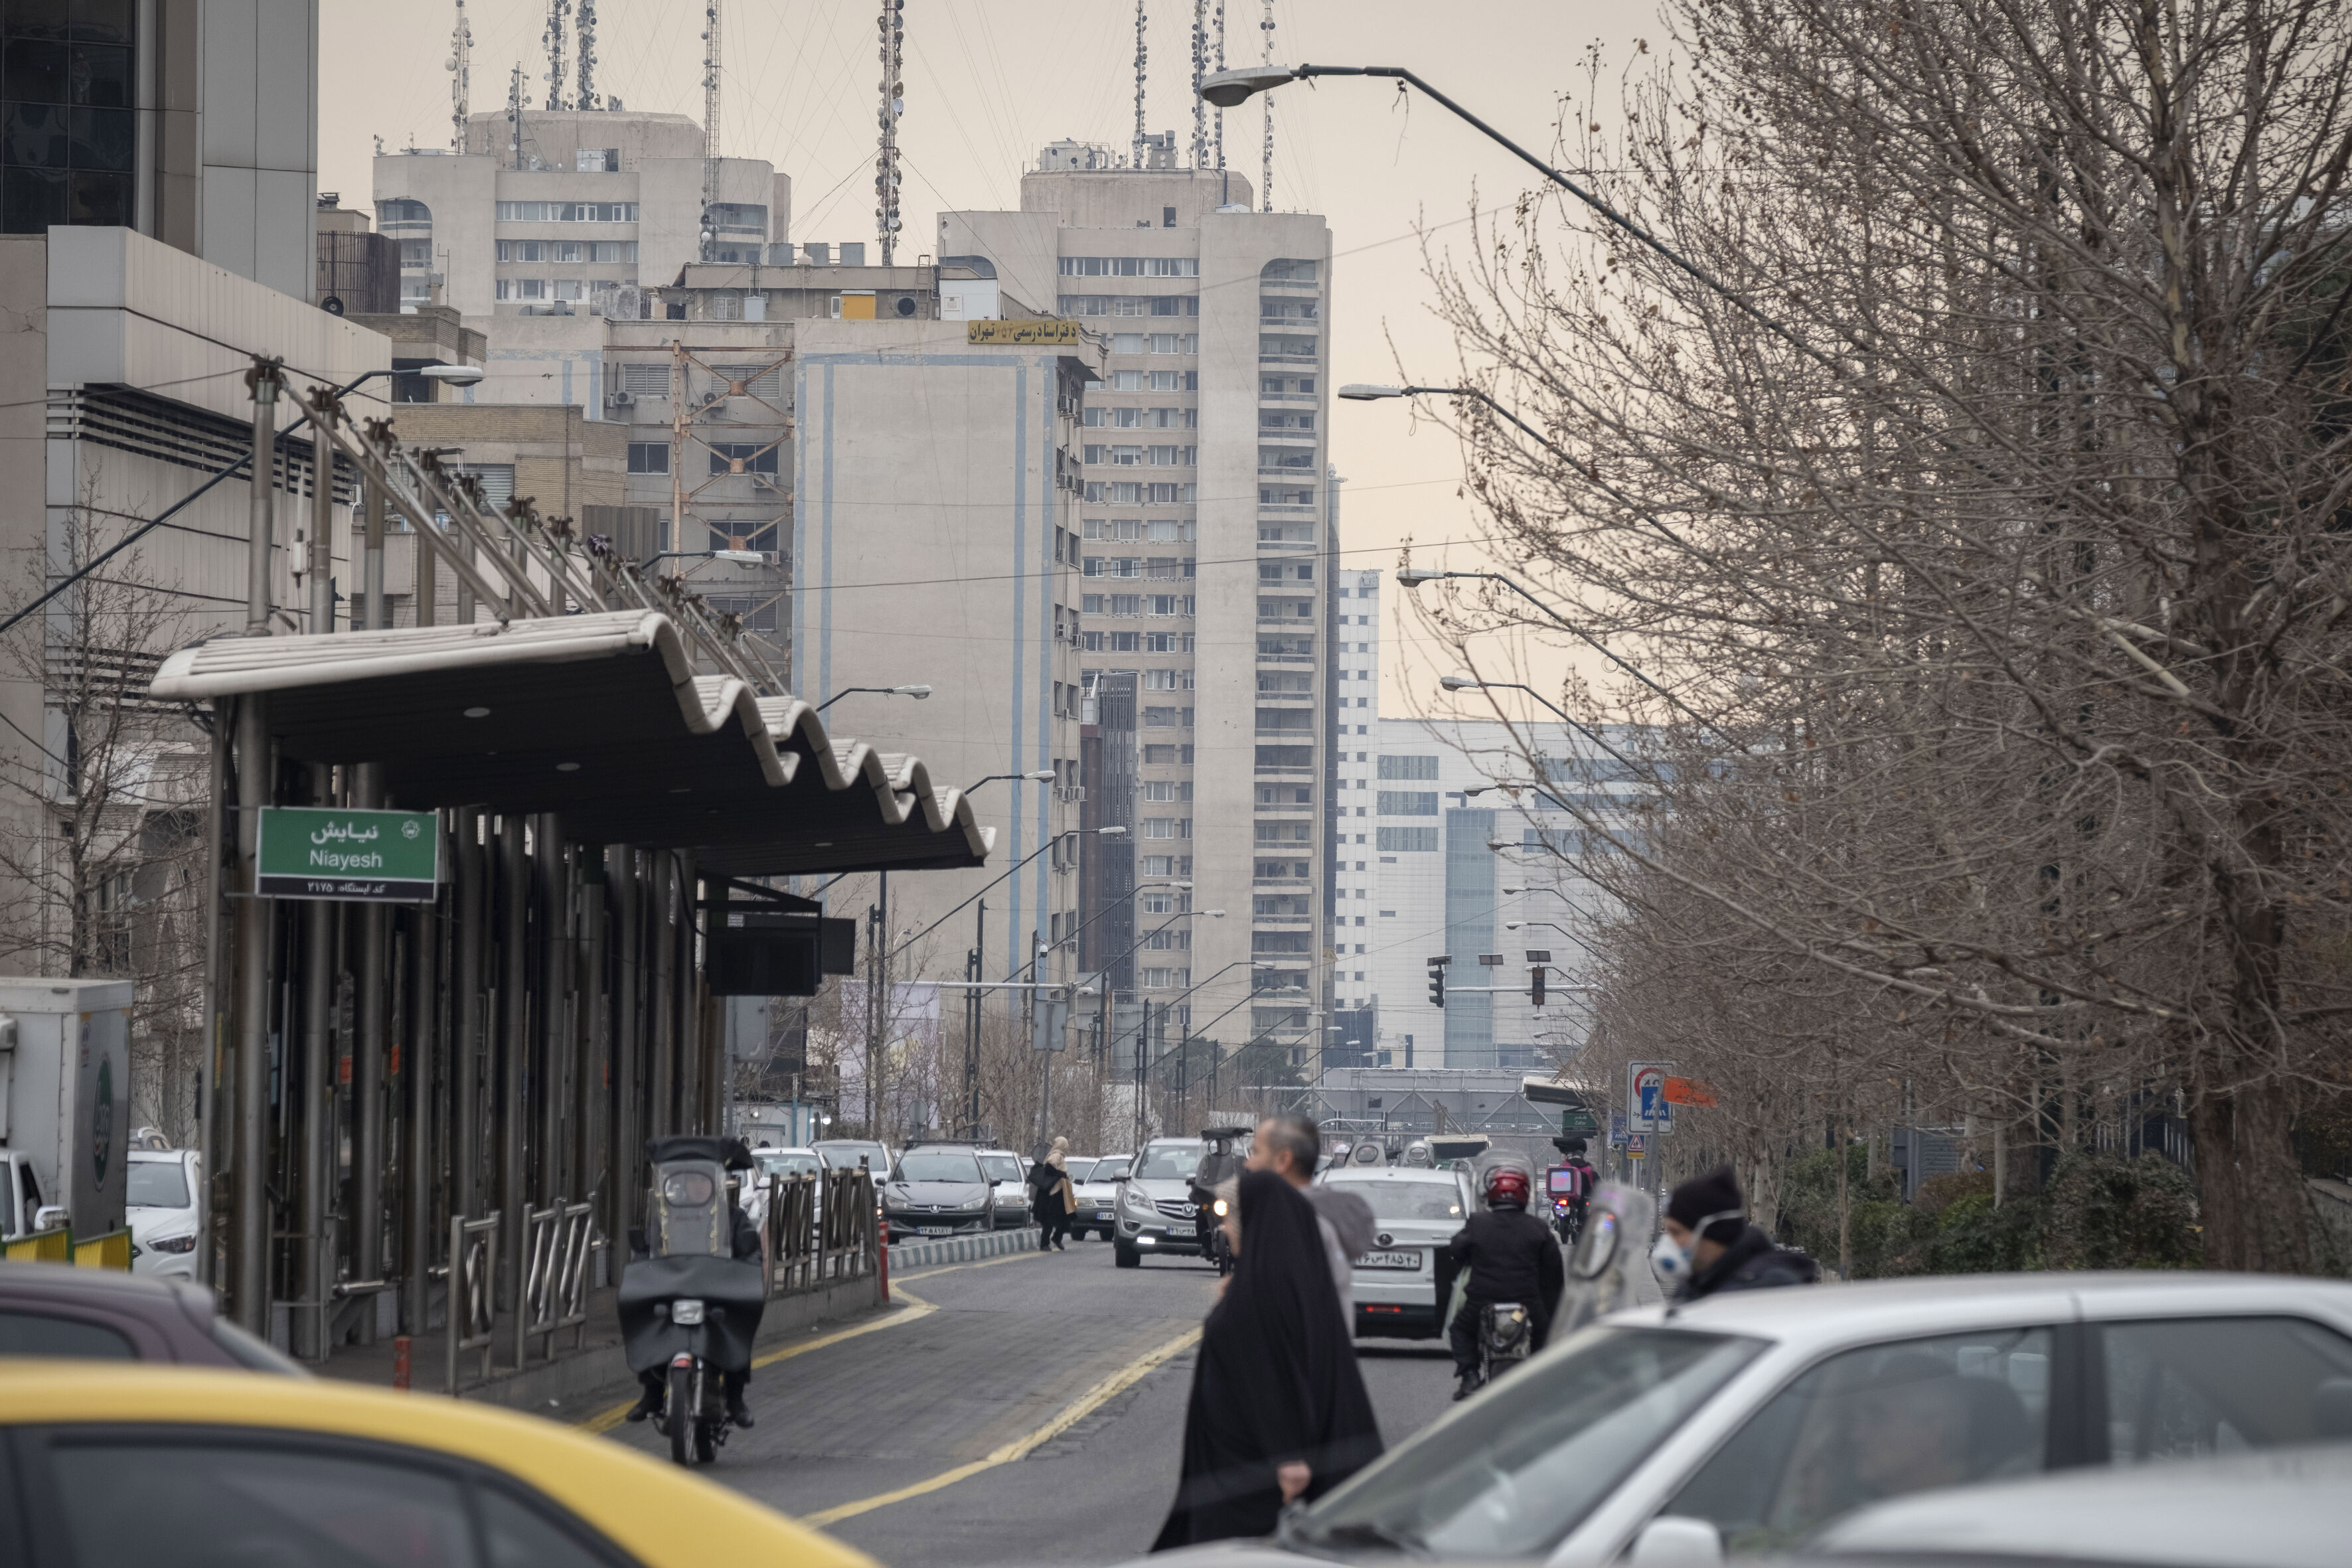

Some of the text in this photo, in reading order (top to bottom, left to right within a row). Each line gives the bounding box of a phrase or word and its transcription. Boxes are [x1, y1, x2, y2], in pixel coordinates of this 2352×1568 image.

[970, 323, 995, 341] تهران
[1014, 329, 1036, 342] رسمی
[1037, 323, 1058, 337] اسناد
[1058, 323, 1076, 342] دفتر
[311, 821, 379, 844] نیایش
[309, 850, 383, 871] Niayesh
[307, 881, 333, 892] ۲۱۷۵
[372, 884, 387, 894] کد
